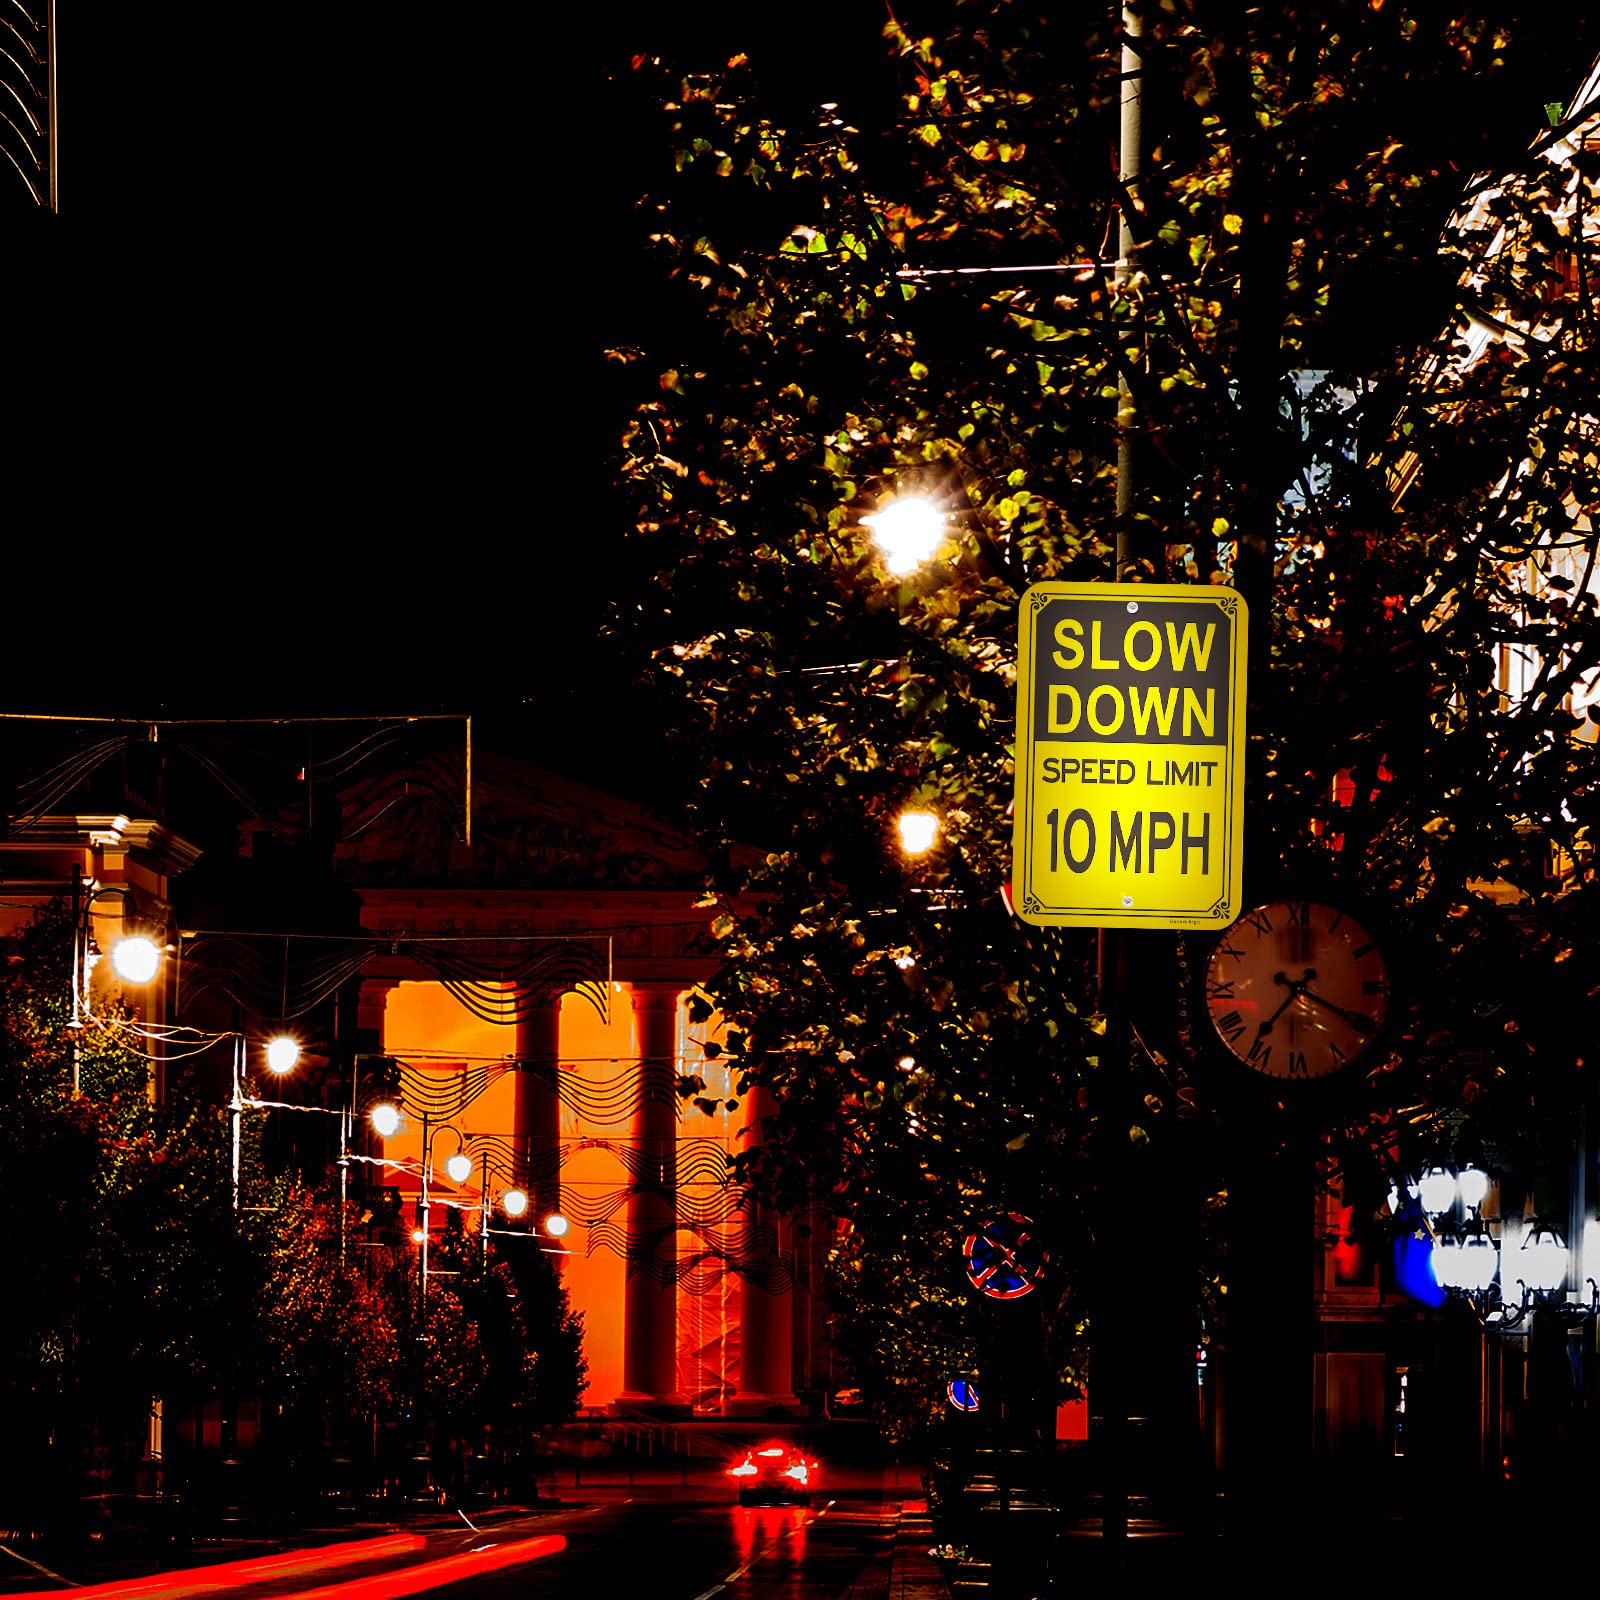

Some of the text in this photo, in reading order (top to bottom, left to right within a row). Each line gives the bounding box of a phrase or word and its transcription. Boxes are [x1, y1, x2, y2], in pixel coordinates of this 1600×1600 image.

[1052, 618, 1217, 672] SLOW
[1047, 684, 1216, 737] DOWN
[1042, 757, 1219, 787] SPEED LIMIT
[1046, 808, 1211, 876] 10 MPH
[1248, 911, 1273, 938] XI
[1287, 904, 1310, 926] XII
[1221, 942, 1246, 963] X
[1212, 981, 1235, 999] IX
[1218, 1010, 1247, 1043] VIII
[1289, 1051, 1308, 1074] VI
